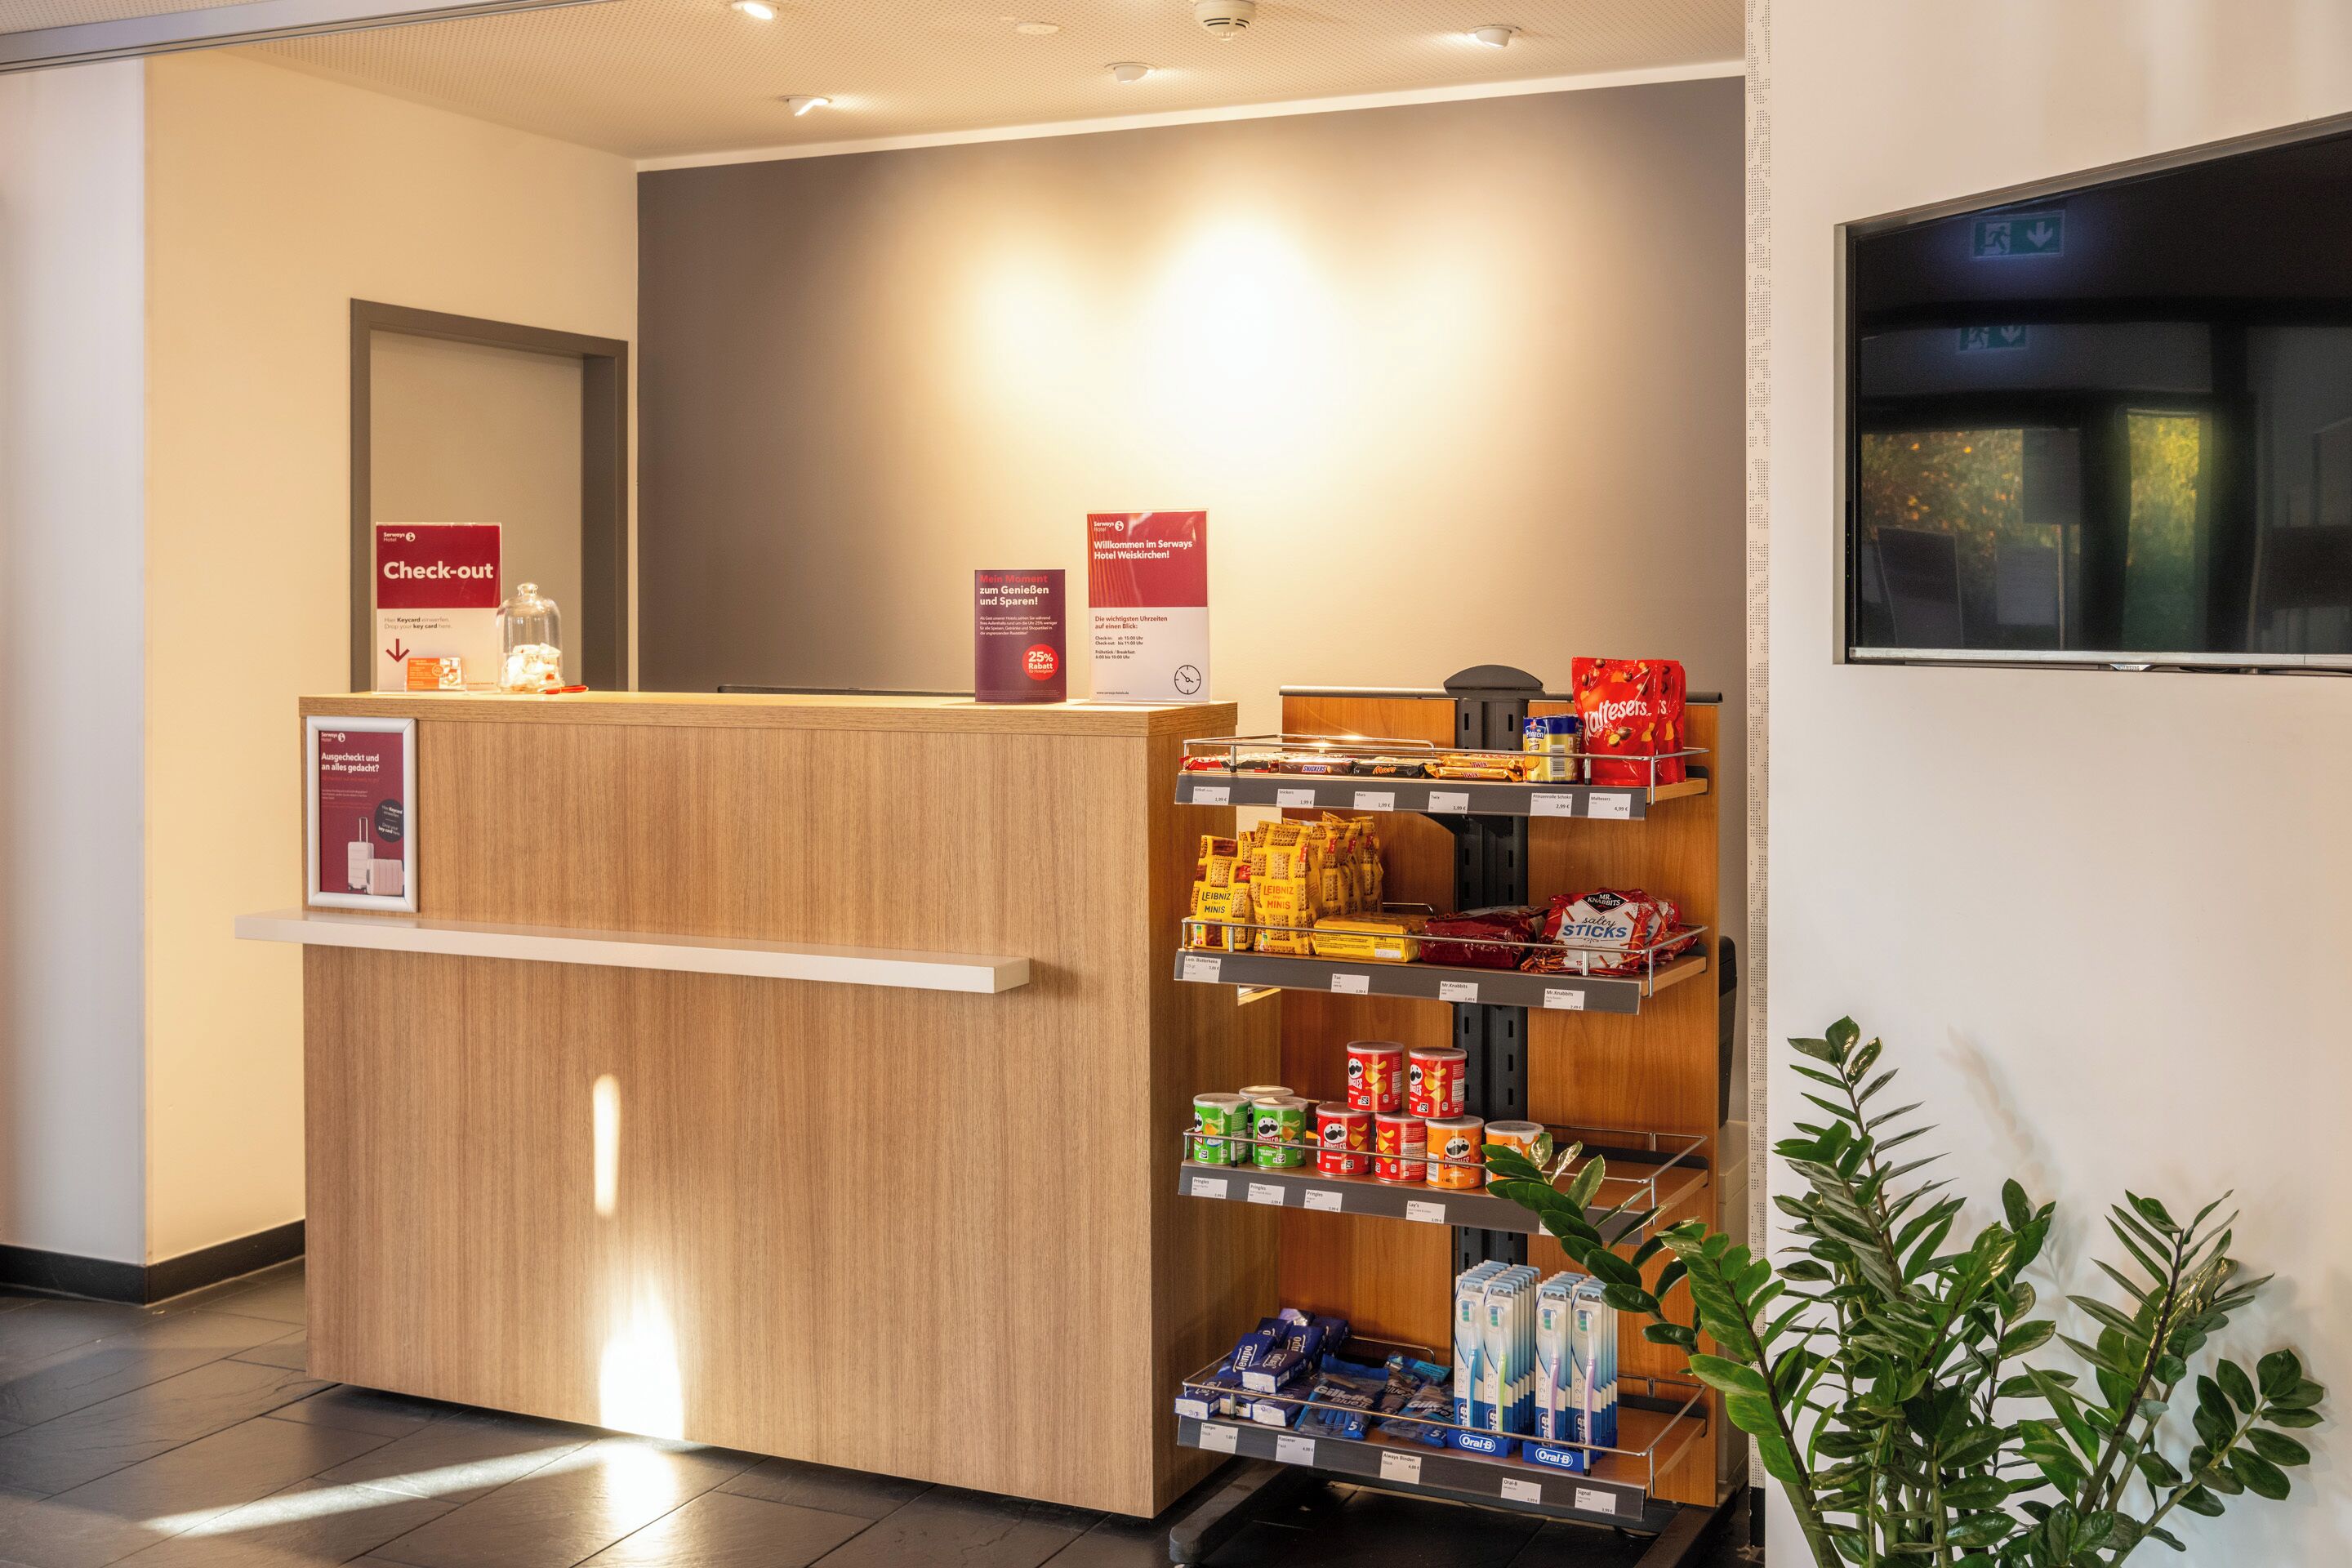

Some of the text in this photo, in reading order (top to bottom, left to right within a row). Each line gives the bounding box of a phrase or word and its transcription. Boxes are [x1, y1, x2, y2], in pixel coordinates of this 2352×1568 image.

[1094, 539, 1192, 550] Willkommen im Serways
[1094, 550, 1169, 559] Hotel Weiskirchen!
[383, 560, 494, 580] Check-out
[980, 575, 1049, 583] Mein Moment
[1000, 585, 1049, 595] Genießen
[980, 597, 1038, 608] und Sparen!
[1029, 651, 1054, 662] 25%
[321, 752, 379, 763] Ausgecheckt und
[332, 763, 346, 771] alles
[348, 764, 379, 773] gedacht?
[1372, 766, 1396, 774] Mars
[1263, 885, 1294, 896] LEIBNIZ
[1202, 892, 1232, 902] LEIBNIZ
[1588, 897, 1620, 906] KNABBITS
[1204, 905, 1225, 914] MINIS
[1267, 900, 1290, 910] MINIS
[1581, 915, 1617, 929] salty
[1562, 924, 1627, 938] STICKS
[1233, 1345, 1254, 1372] Tempo
[1313, 1385, 1374, 1405] Gillette
[1348, 1421, 1358, 1431] 5
[1430, 1429, 1441, 1437] 5
[1461, 1436, 1494, 1450] Oral-B
[1383, 1454, 1399, 1462] Always
[1538, 1450, 1571, 1465] Oral-B
